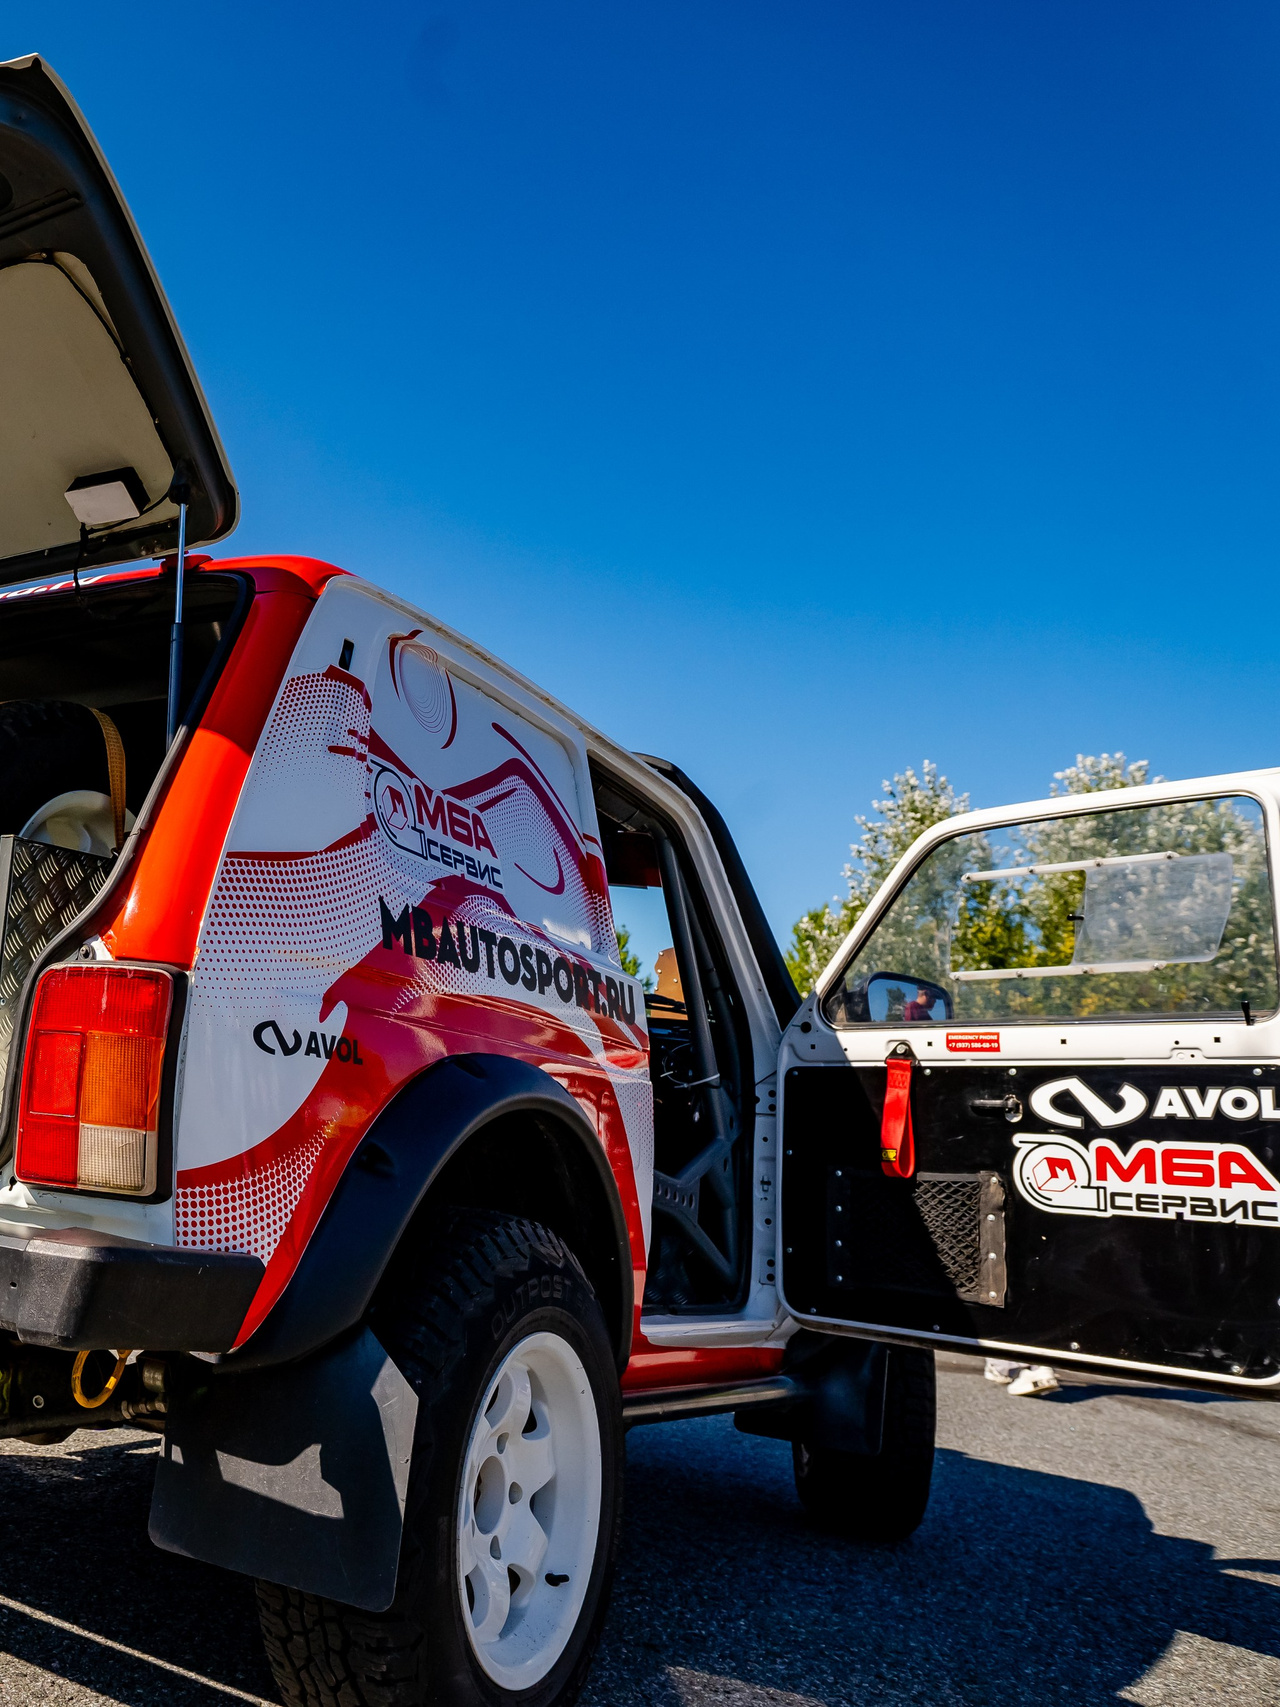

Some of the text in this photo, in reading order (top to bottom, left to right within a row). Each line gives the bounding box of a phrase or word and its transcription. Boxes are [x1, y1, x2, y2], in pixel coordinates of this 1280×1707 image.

[414, 784, 498, 859] МБА
[427, 838, 503, 889] СЕРВИС
[378, 894, 636, 1026] MBAUTOSPORT.RU
[304, 1031, 363, 1065] AVOL
[1150, 1086, 1280, 1120] AVOL
[1095, 1146, 1276, 1191] МБА
[1110, 1192, 1279, 1222] СЕРВИС
[491, 1274, 572, 1341] OUTPOST
